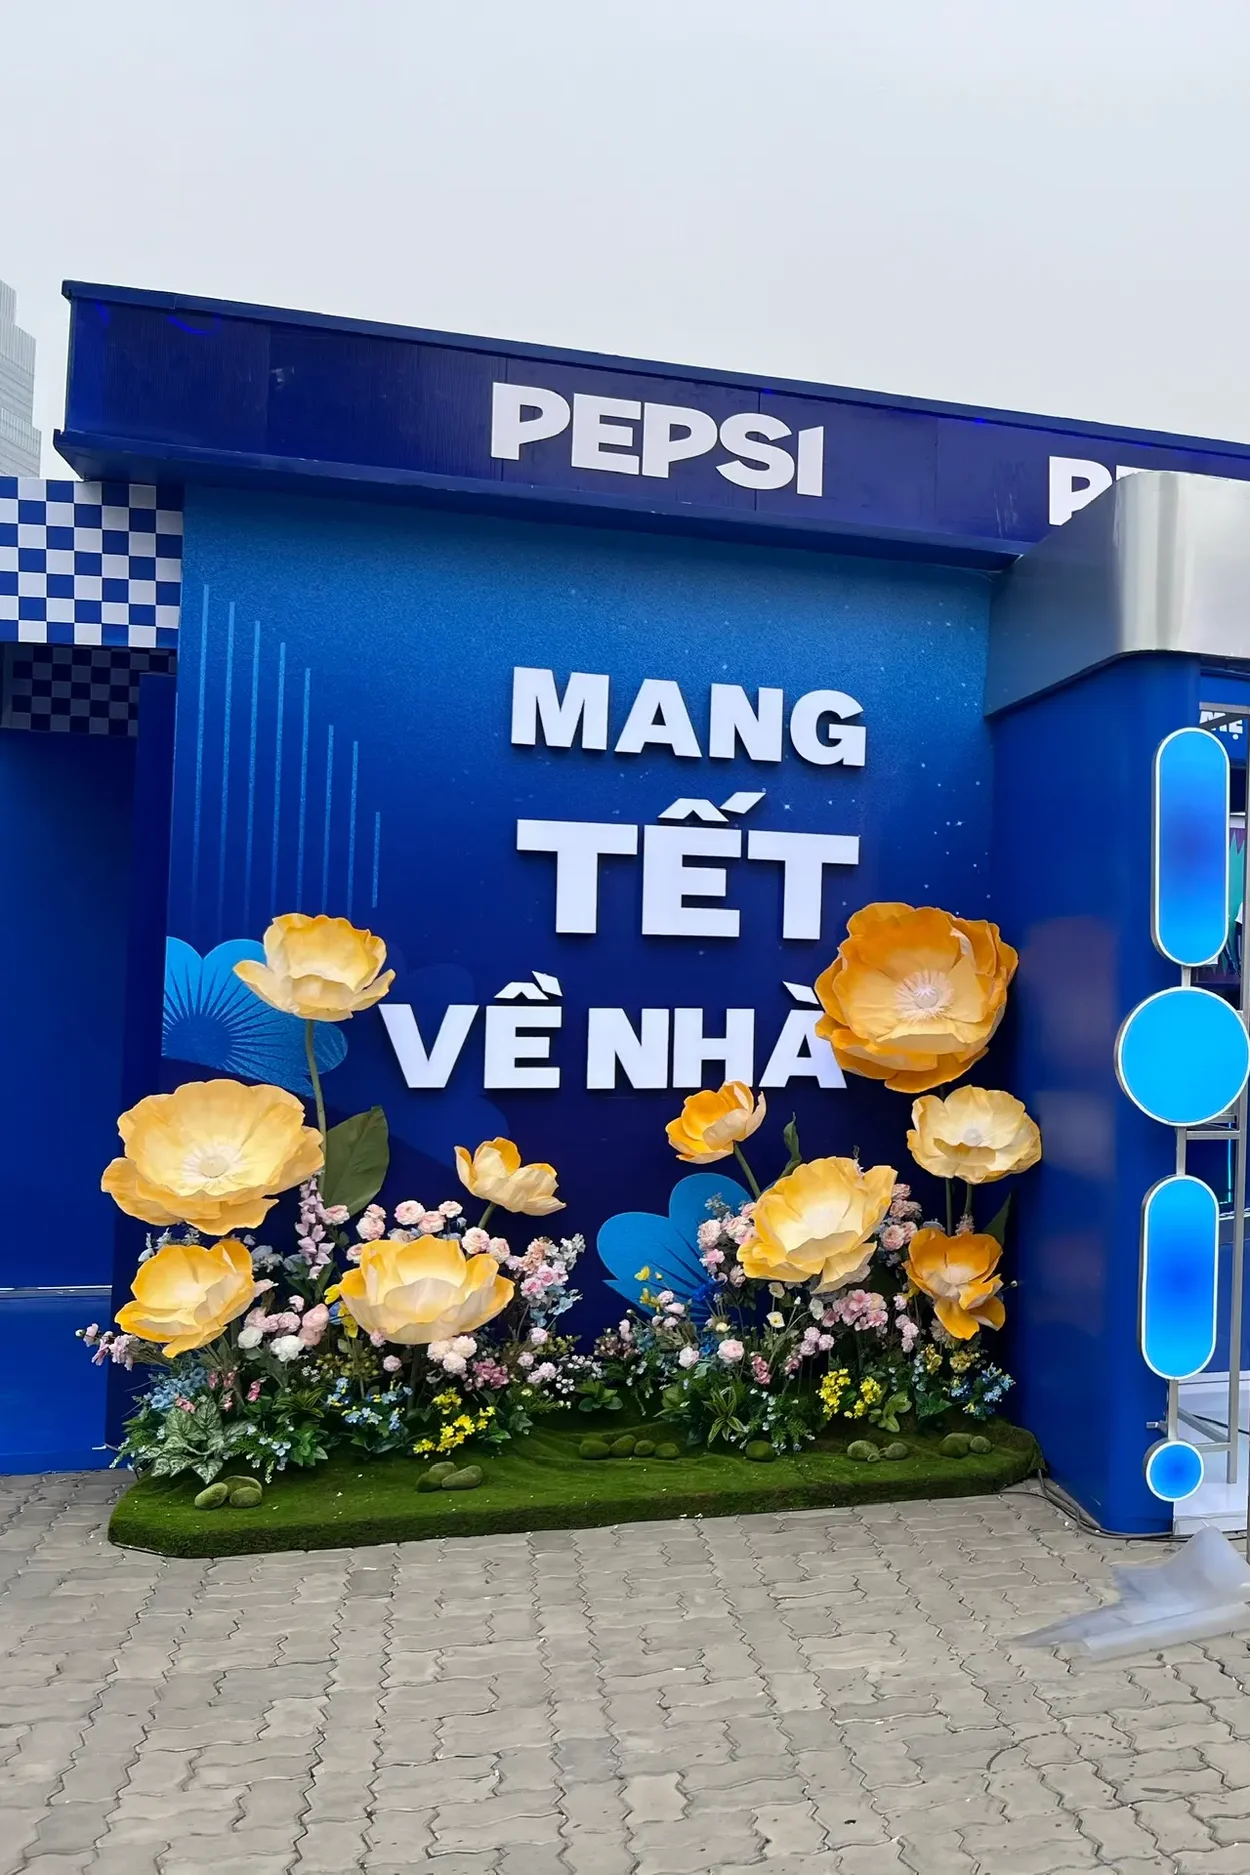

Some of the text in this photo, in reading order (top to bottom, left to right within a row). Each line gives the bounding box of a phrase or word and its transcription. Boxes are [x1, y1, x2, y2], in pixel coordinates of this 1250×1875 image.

[491, 382, 824, 497] PEPSI
[511, 666, 867, 767] MANG
[516, 791, 860, 940] TẾT
[378, 970, 847, 1089] VỀ NHÀ
